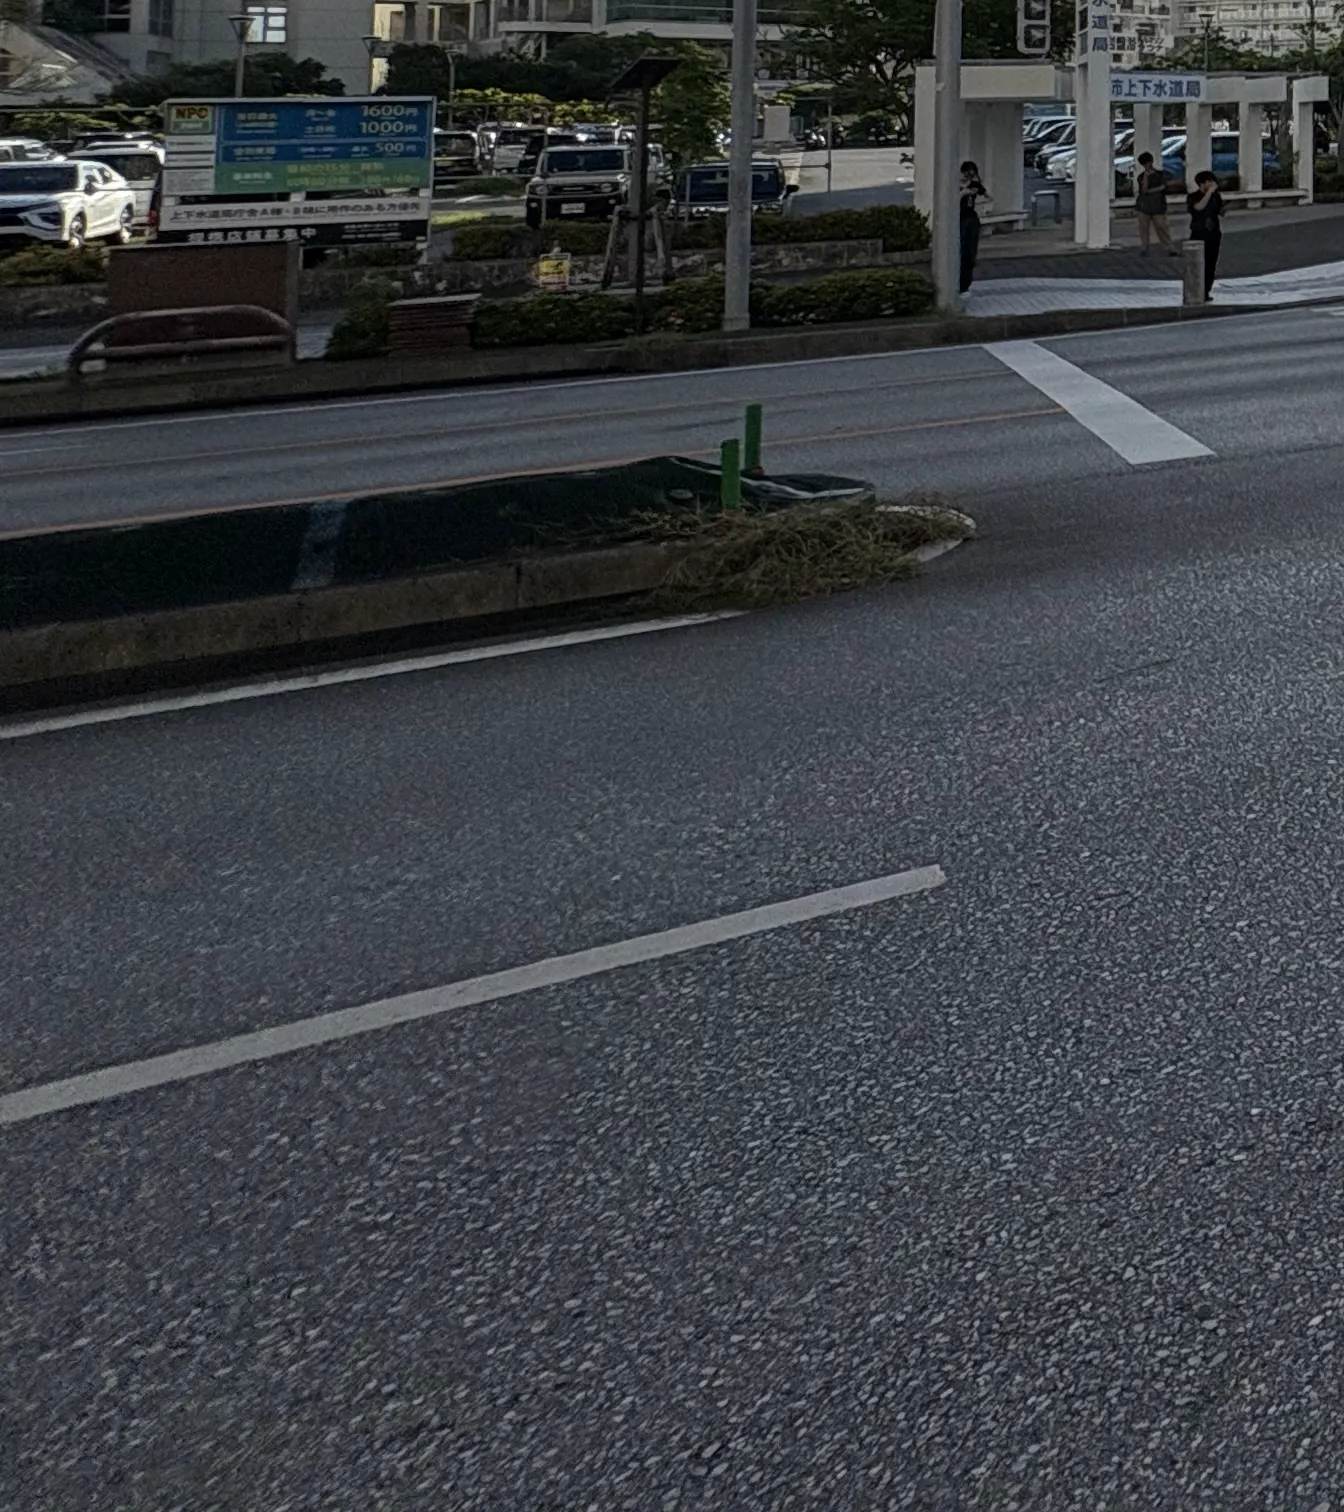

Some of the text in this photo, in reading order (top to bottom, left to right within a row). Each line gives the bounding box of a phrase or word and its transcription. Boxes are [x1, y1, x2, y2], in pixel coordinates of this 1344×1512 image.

[1111, 79, 1200, 99] 市上下水道局
[175, 107, 209, 119] NPC
